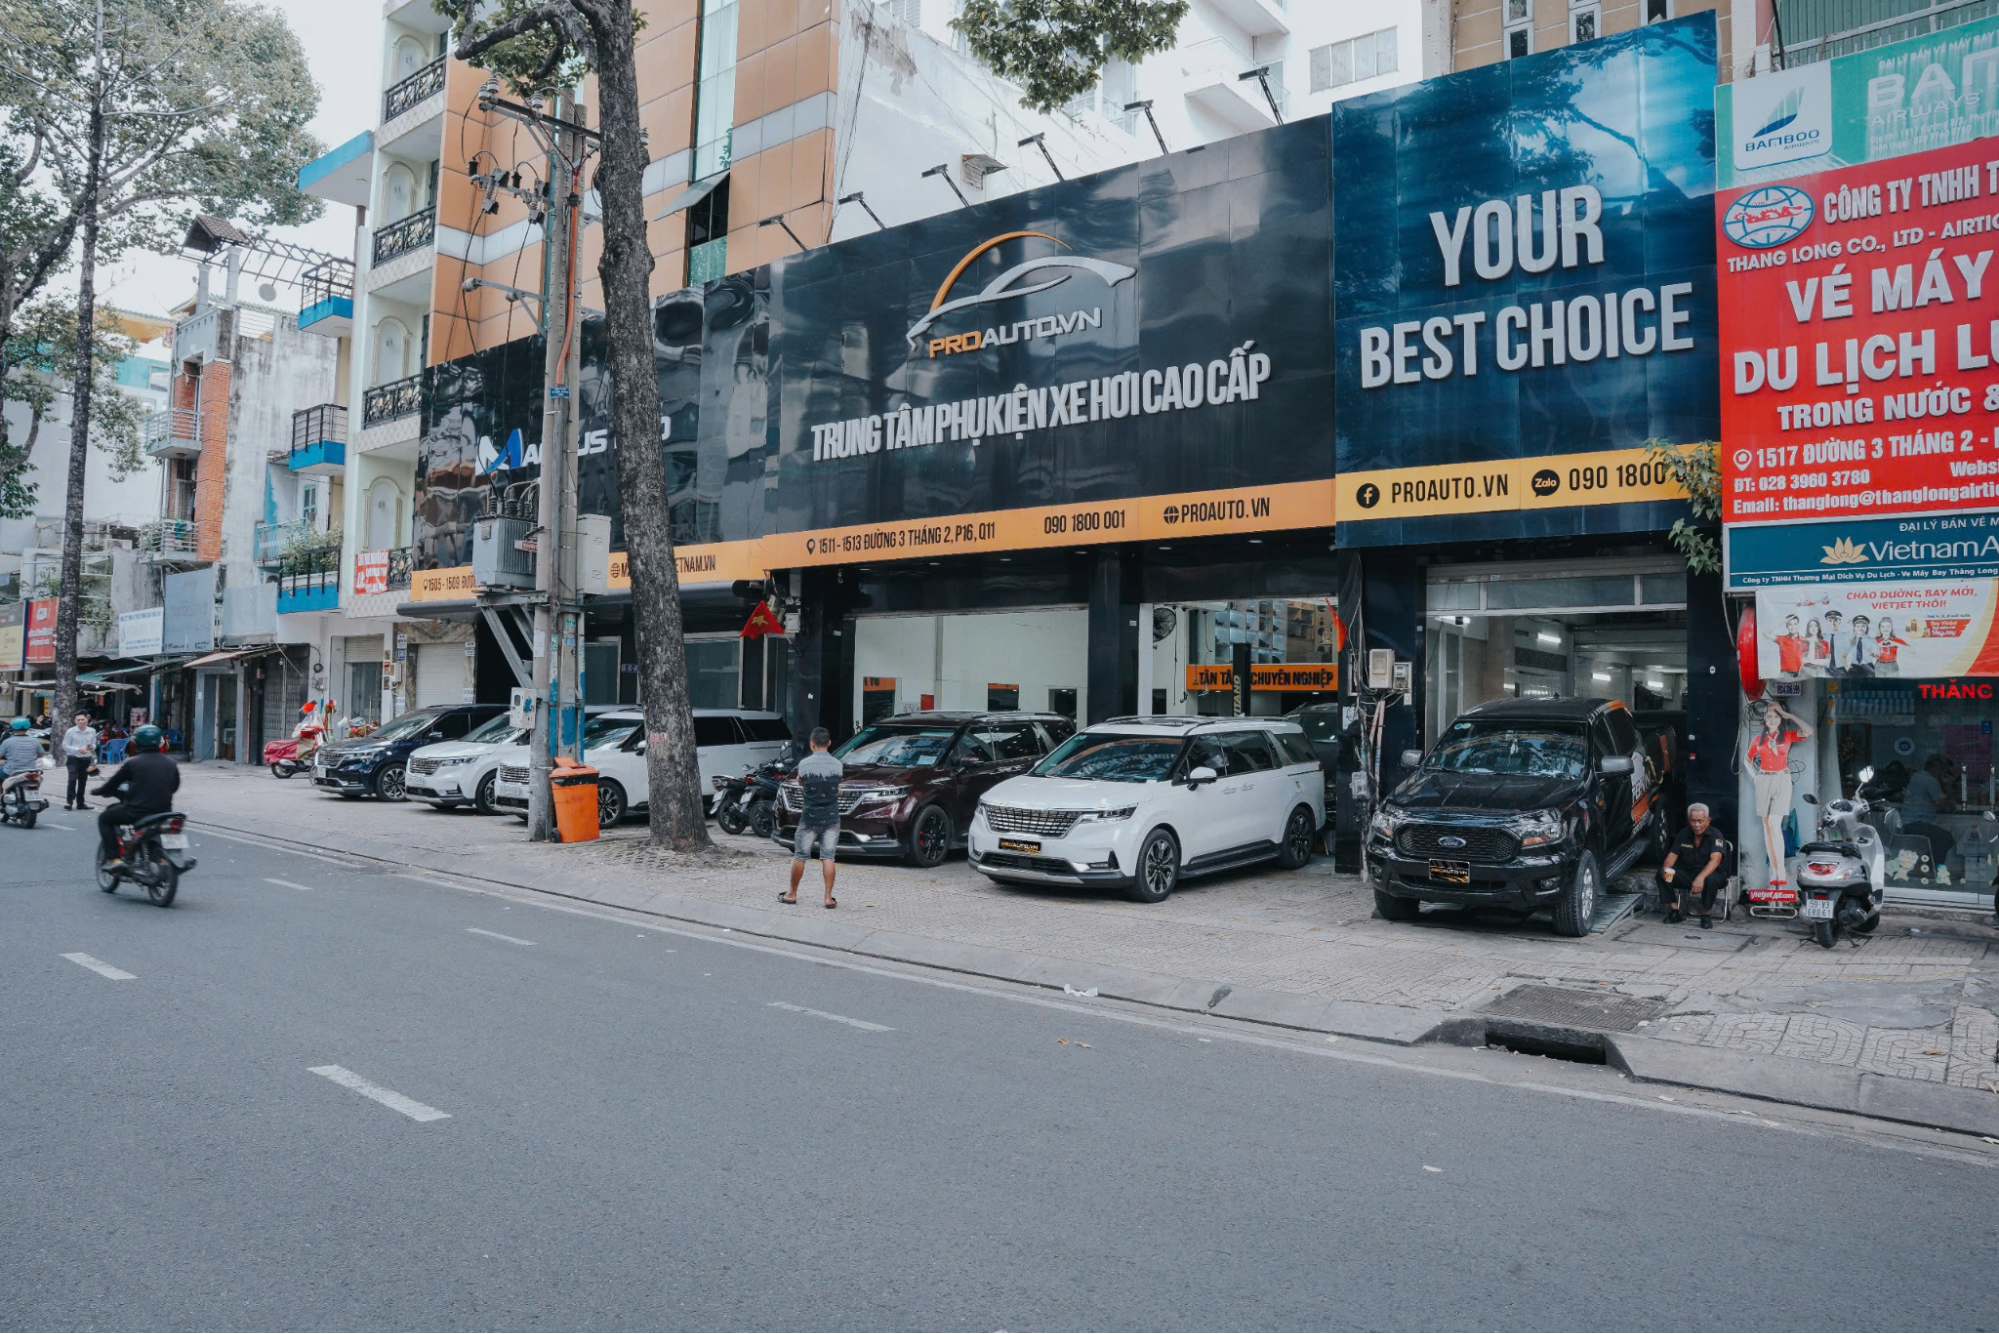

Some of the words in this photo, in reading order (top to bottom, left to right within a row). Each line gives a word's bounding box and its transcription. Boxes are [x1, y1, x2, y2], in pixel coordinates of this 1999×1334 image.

[1870, 92, 1981, 128] AIRWAYS
[1823, 184, 1882, 224] CÔNG
[1886, 177, 1913, 213] TY
[1918, 164, 1979, 207] TNHH
[1429, 185, 1604, 287] YOUR
[1727, 251, 1787, 273] THANG
[1792, 242, 1842, 264] LONG
[1893, 227, 1924, 247] LTD
[1786, 263, 1853, 322] VÉ
[1872, 248, 1994, 313] MÁY
[929, 306, 1102, 359] PROAUTO.VN
[1360, 311, 1485, 389] BEST
[1495, 282, 1694, 371] CHOICE
[1734, 346, 1798, 395] DU
[1816, 329, 1935, 395] LỊCH
[811, 414, 882, 461] TRUNG
[883, 402, 935, 450] TÂM
[935, 397, 986, 446] PHỤ
[986, 383, 1047, 440] KIỆN
[1049, 380, 1088, 427] XE
[1090, 371, 1140, 421] HƠI
[1142, 362, 1204, 414] CAO
[1207, 339, 1271, 405] CẤP
[1777, 397, 1874, 430] TRONG
[1884, 381, 1971, 421] NƯỚC
[1757, 446, 1798, 468] 1517
[1803, 437, 1866, 464] ĐƯỜNG
[1871, 438, 1883, 458] 3
[1888, 429, 1954, 457] THÁNG
[1960, 430, 1973, 452] 2
[1392, 474, 1508, 503] PROAUTO.VN
[1535, 478, 1557, 488] Zalo
[1569, 466, 1608, 491] 090
[1616, 461, 1666, 487] 1800
[1734, 478, 1755, 492] ĐT:
[1759, 476, 1786, 491] 028
[1790, 472, 1828, 489] 3960
[1831, 469, 1870, 486] 3780
[1950, 459, 1999, 477] Webs
[1044, 516, 1067, 534] 090
[1071, 512, 1100, 532] 1800
[1103, 509, 1126, 529] 001
[1733, 497, 1780, 514] Email:
[863, 528, 896, 550] ĐƯỜNG
[899, 530, 905, 547] 3
[908, 525, 942, 546] THÁNG
[979, 521, 996, 540] Q11
[1899, 522, 1920, 533] ĐẠI
[1923, 519, 1938, 530] LÝ
[1941, 518, 1966, 529] BÁN
[1971, 516, 1986, 527] VÉ
[1932, 569, 1947, 577] Bay
[1978, 567, 1998, 576] Long
[1846, 588, 1877, 600] CHÀO
[1925, 588, 1948, 598] BAY
[1871, 600, 1912, 610] VIETJET
[1251, 669, 1290, 686] CHUYÊN
[1293, 669, 1333, 688] NGHIỆP
